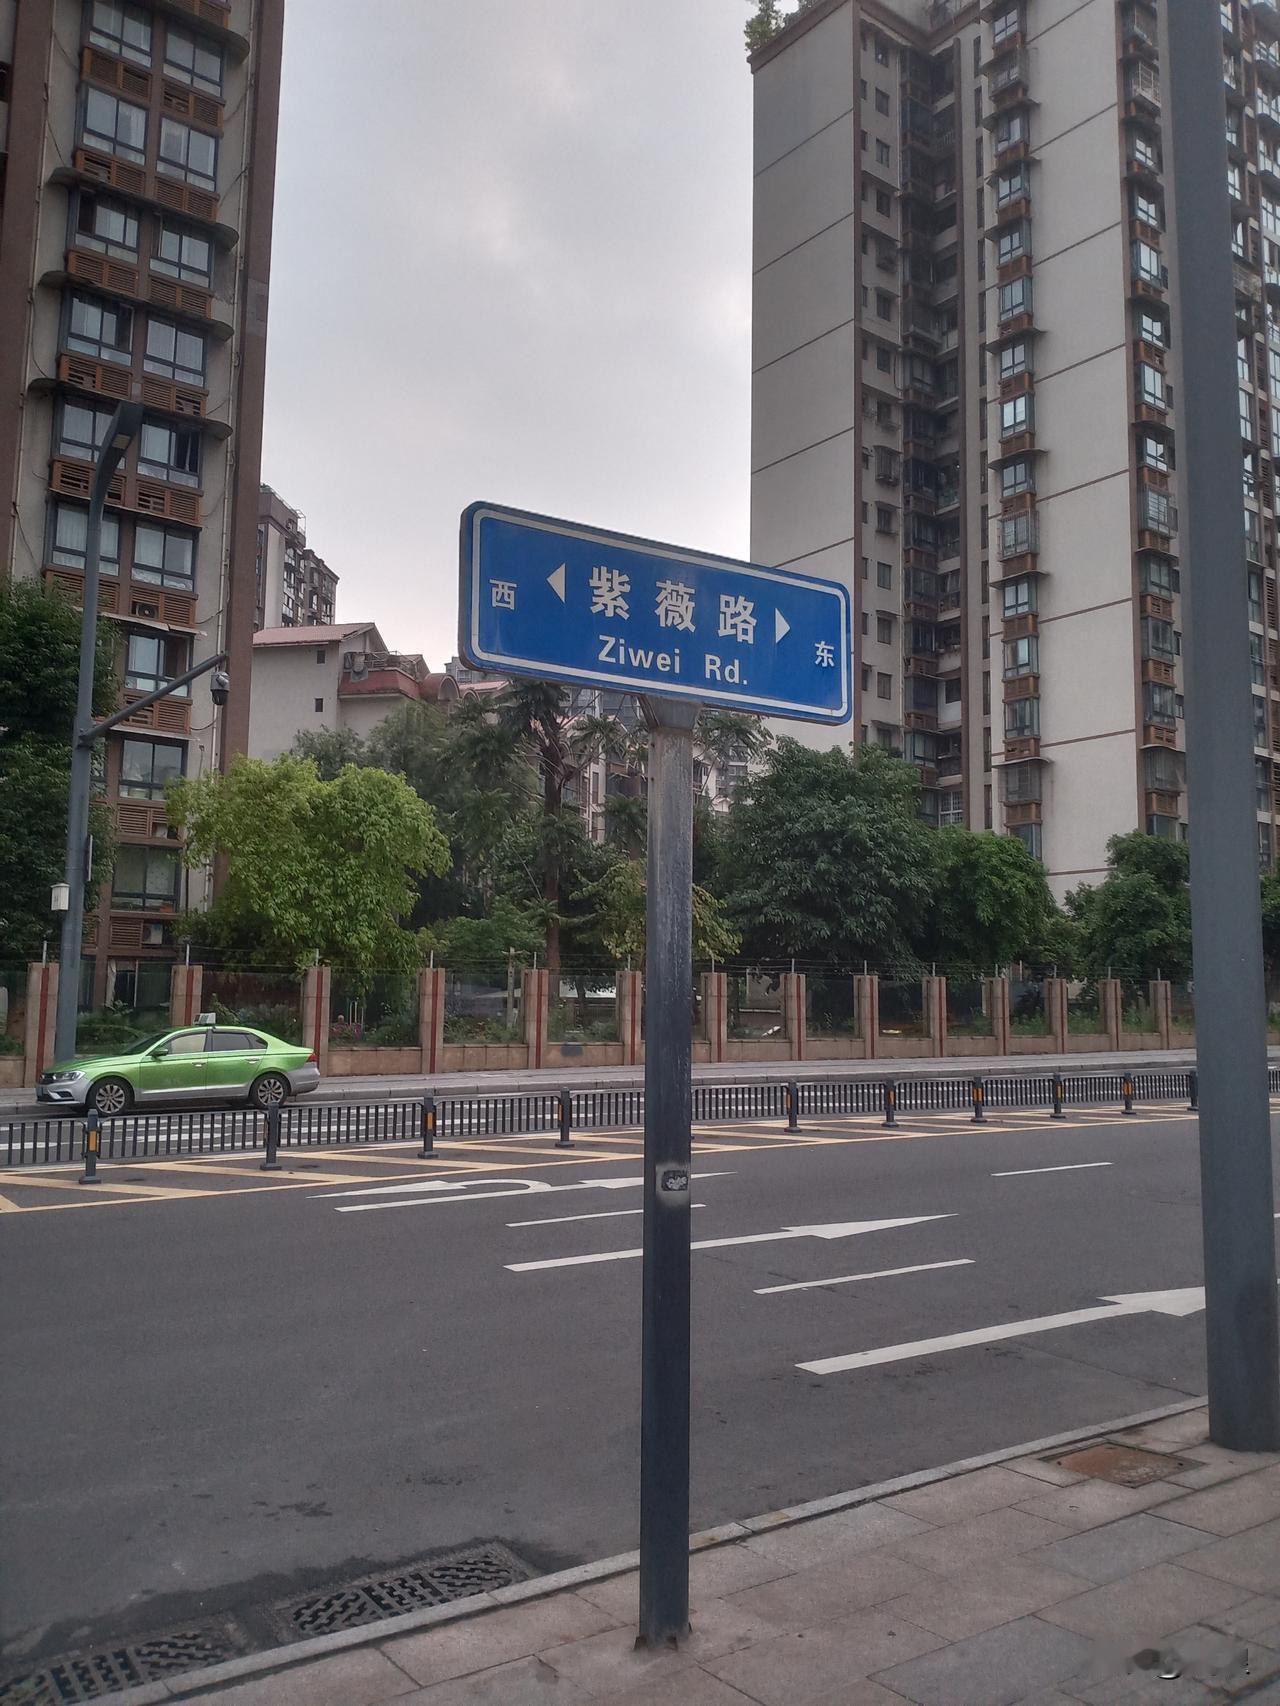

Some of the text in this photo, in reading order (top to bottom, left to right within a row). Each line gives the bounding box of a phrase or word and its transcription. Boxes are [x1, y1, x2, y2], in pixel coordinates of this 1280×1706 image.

[489, 578, 518, 610] 西
[589, 566, 758, 644] 紫薇路
[598, 634, 748, 685] Ziwei Rd.
[814, 640, 835, 668] 东
